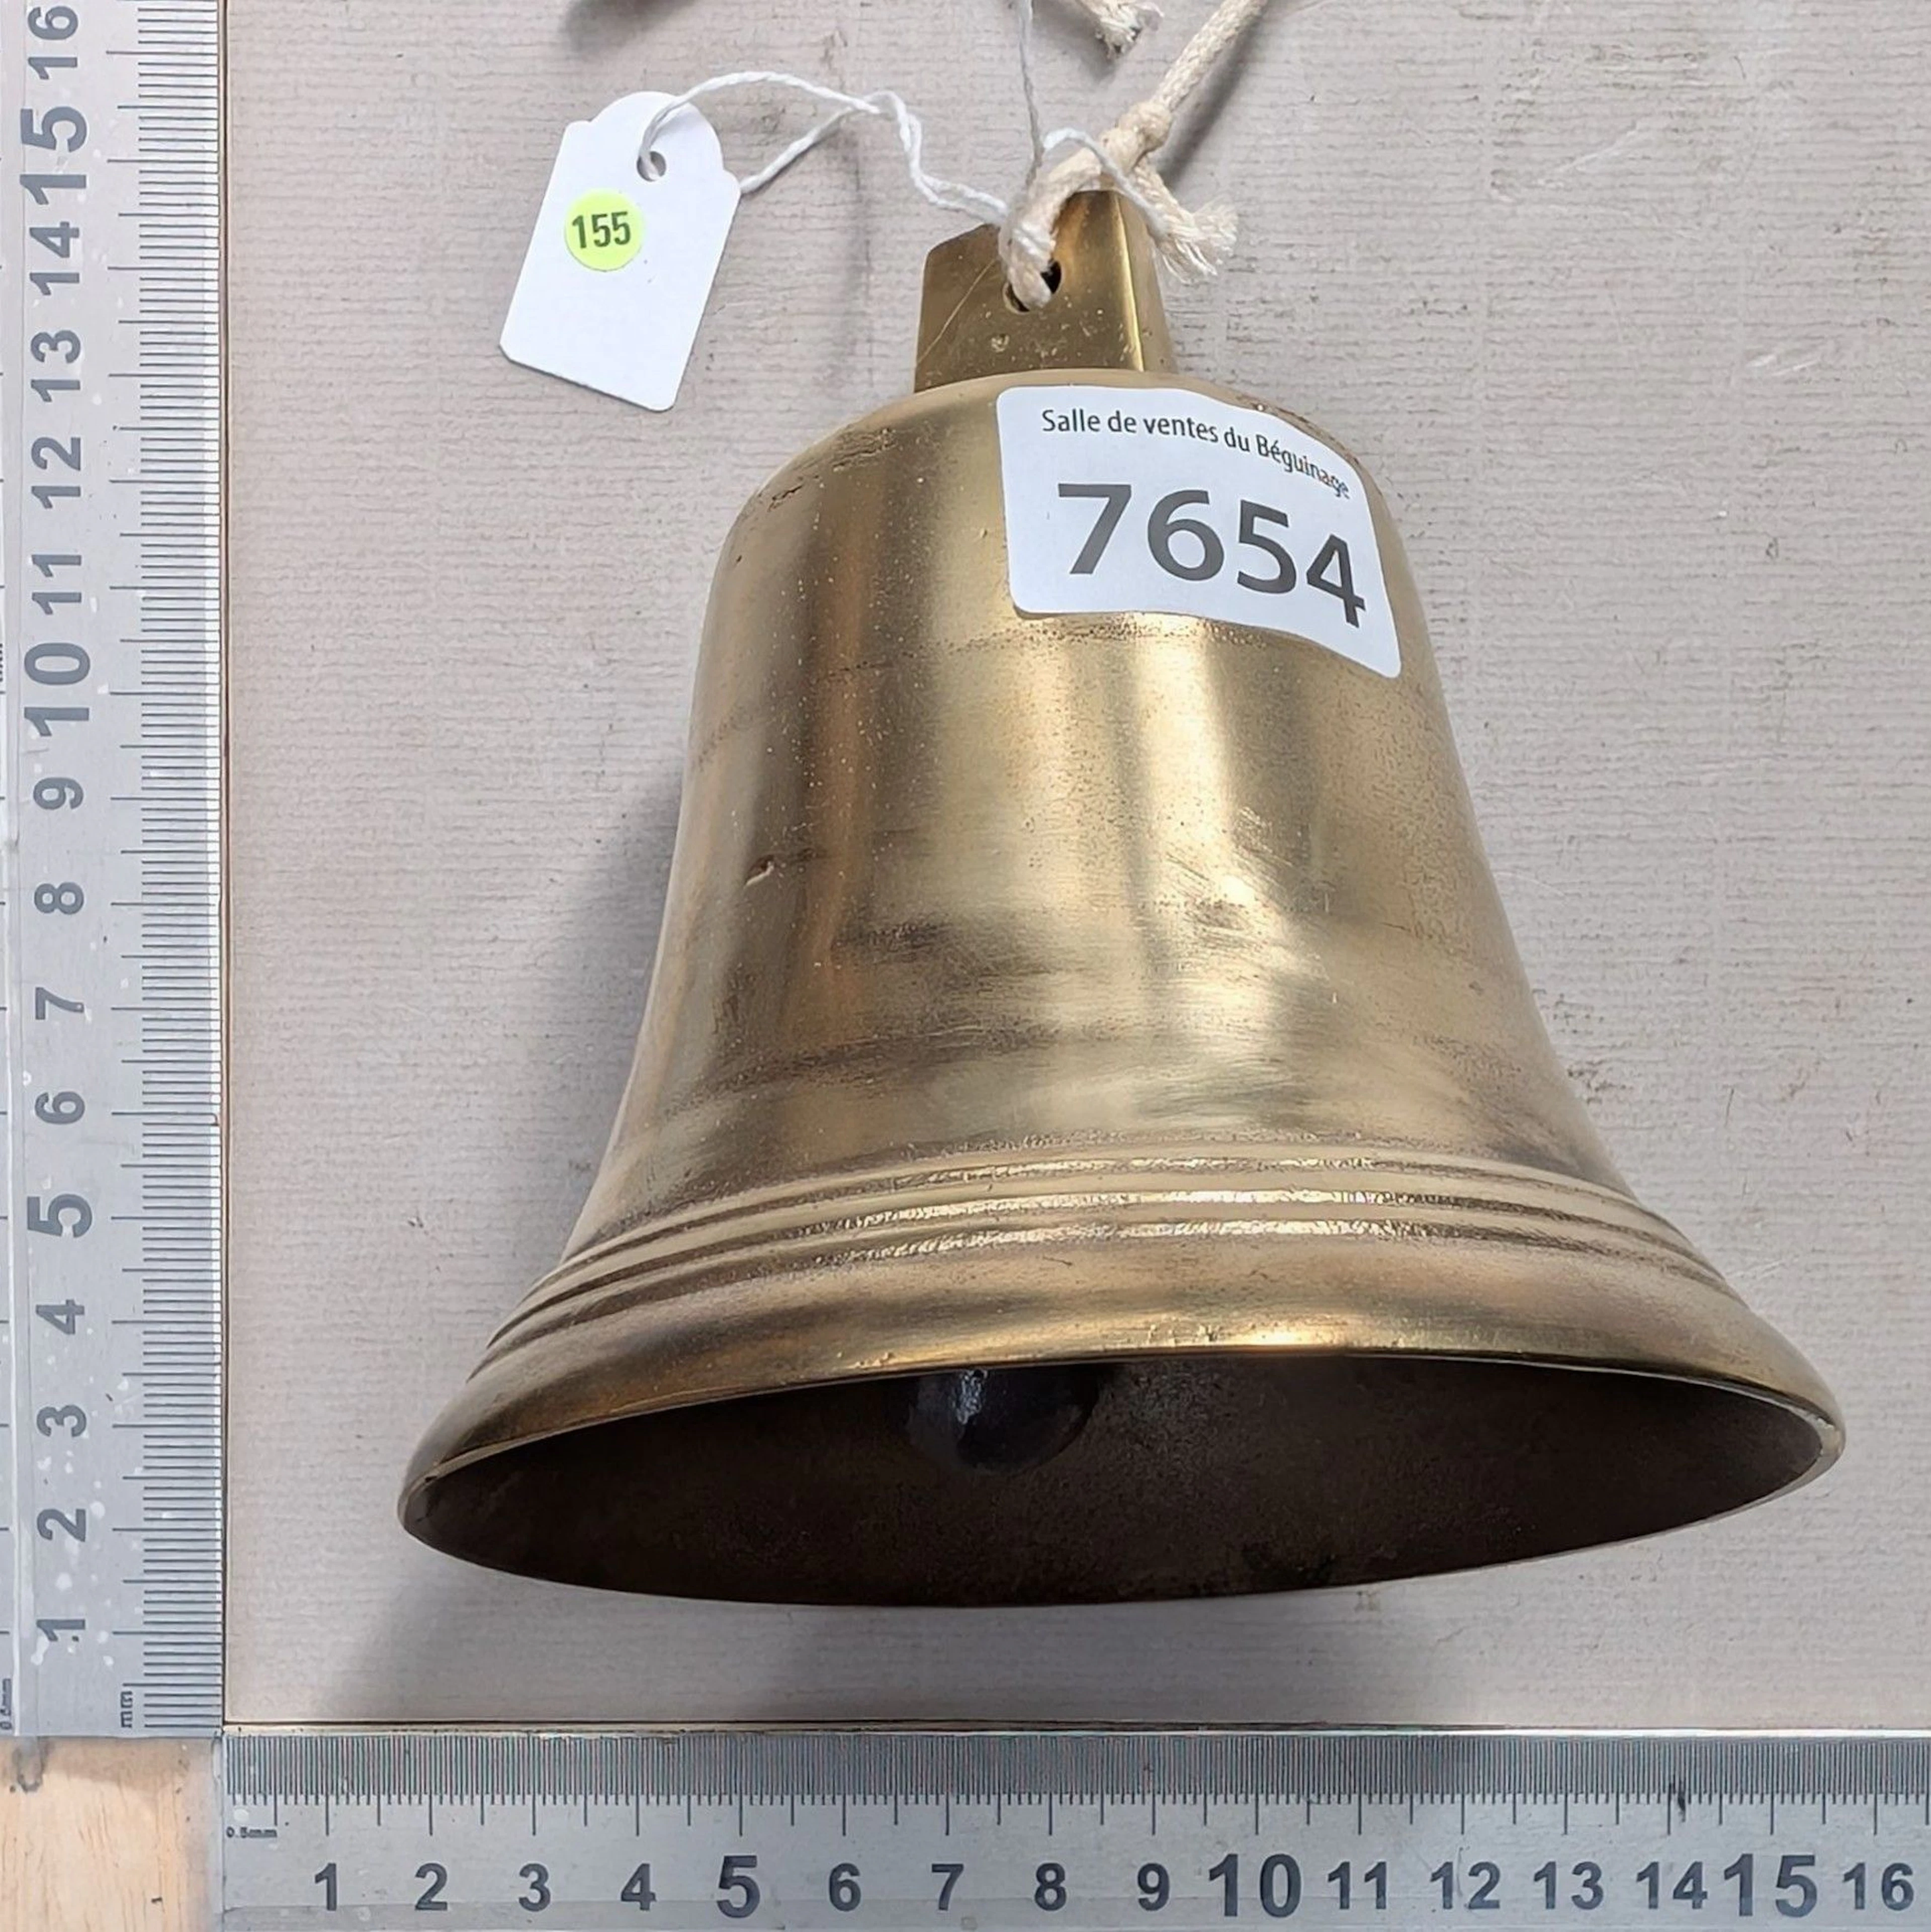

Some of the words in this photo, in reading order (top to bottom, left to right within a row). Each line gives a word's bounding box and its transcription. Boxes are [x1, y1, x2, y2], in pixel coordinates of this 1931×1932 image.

[28, 6, 78, 79] 16
[20, 107, 86, 205] 15
[572, 211, 631, 249] 155
[29, 222, 79, 296] 14
[31, 330, 80, 402] 13
[31, 437, 81, 509] 12
[1042, 408, 1100, 432] Salle
[1108, 410, 1137, 433] de
[1144, 417, 1218, 443] ventes
[1224, 426, 1251, 453] du
[1256, 434, 1350, 499] Béguinage
[1058, 483, 1366, 629] 7654
[32, 555, 81, 614] 11
[24, 643, 90, 737] 10
[33, 778, 83, 810] 9
[34, 883, 84, 915] 8
[35, 987, 84, 1020] 7
[35, 1092, 84, 1124] 6
[27, 1194, 92, 1238] 5
[36, 1299, 84, 1335] 4
[37, 1405, 86, 1437] 3
[37, 1509, 86, 1542] 2
[36, 1619, 85, 1642] 1
[120, 1691, 133, 1728] mm
[226, 1826, 277, 1838] 0.5mm
[315, 1863, 337, 1911] 1
[414, 1863, 448, 1911] 2
[519, 1864, 550, 1912] 3
[621, 1864, 656, 1911] 4
[717, 1856, 759, 1918] 5
[829, 1863, 860, 1911] 6
[932, 1864, 963, 1911] 7
[1034, 1863, 1066, 1911] 8
[1137, 1863, 1169, 1911] 9
[1209, 1854, 1300, 1918] 10
[1328, 1862, 1386, 1909] 11
[1430, 1862, 1500, 1910] 12
[1534, 1862, 1603, 1910] 13
[1636, 1862, 1707, 1909] 14
[1724, 1854, 1817, 1917] 15
[1843, 1862, 1913, 1911] 16
